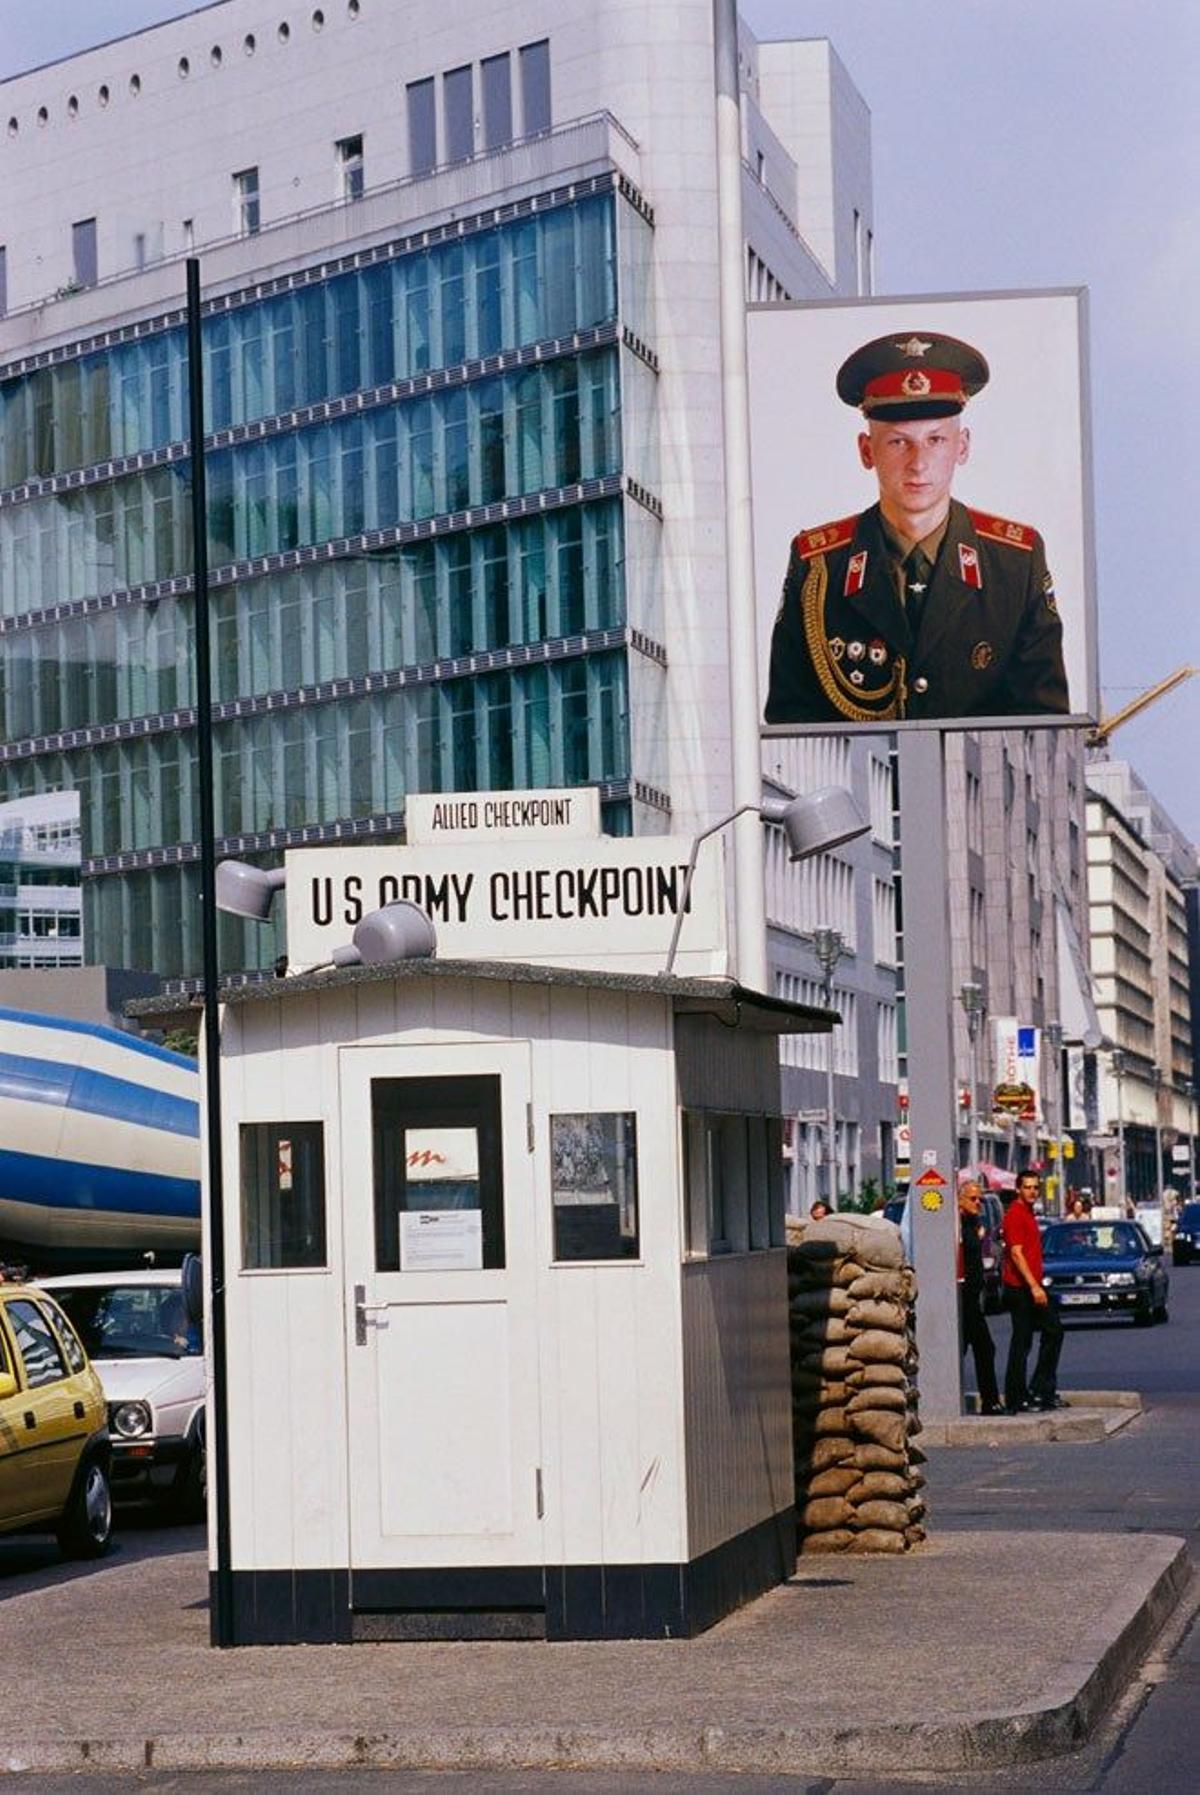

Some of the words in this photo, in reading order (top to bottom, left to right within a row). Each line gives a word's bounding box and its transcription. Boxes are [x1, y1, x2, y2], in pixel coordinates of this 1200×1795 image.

[432, 803, 478, 830] ALLIED
[484, 799, 572, 828] CHECKPOINT
[312, 877, 333, 926] U
[344, 875, 362, 925] S
[490, 865, 696, 921] CHECKPOINT
